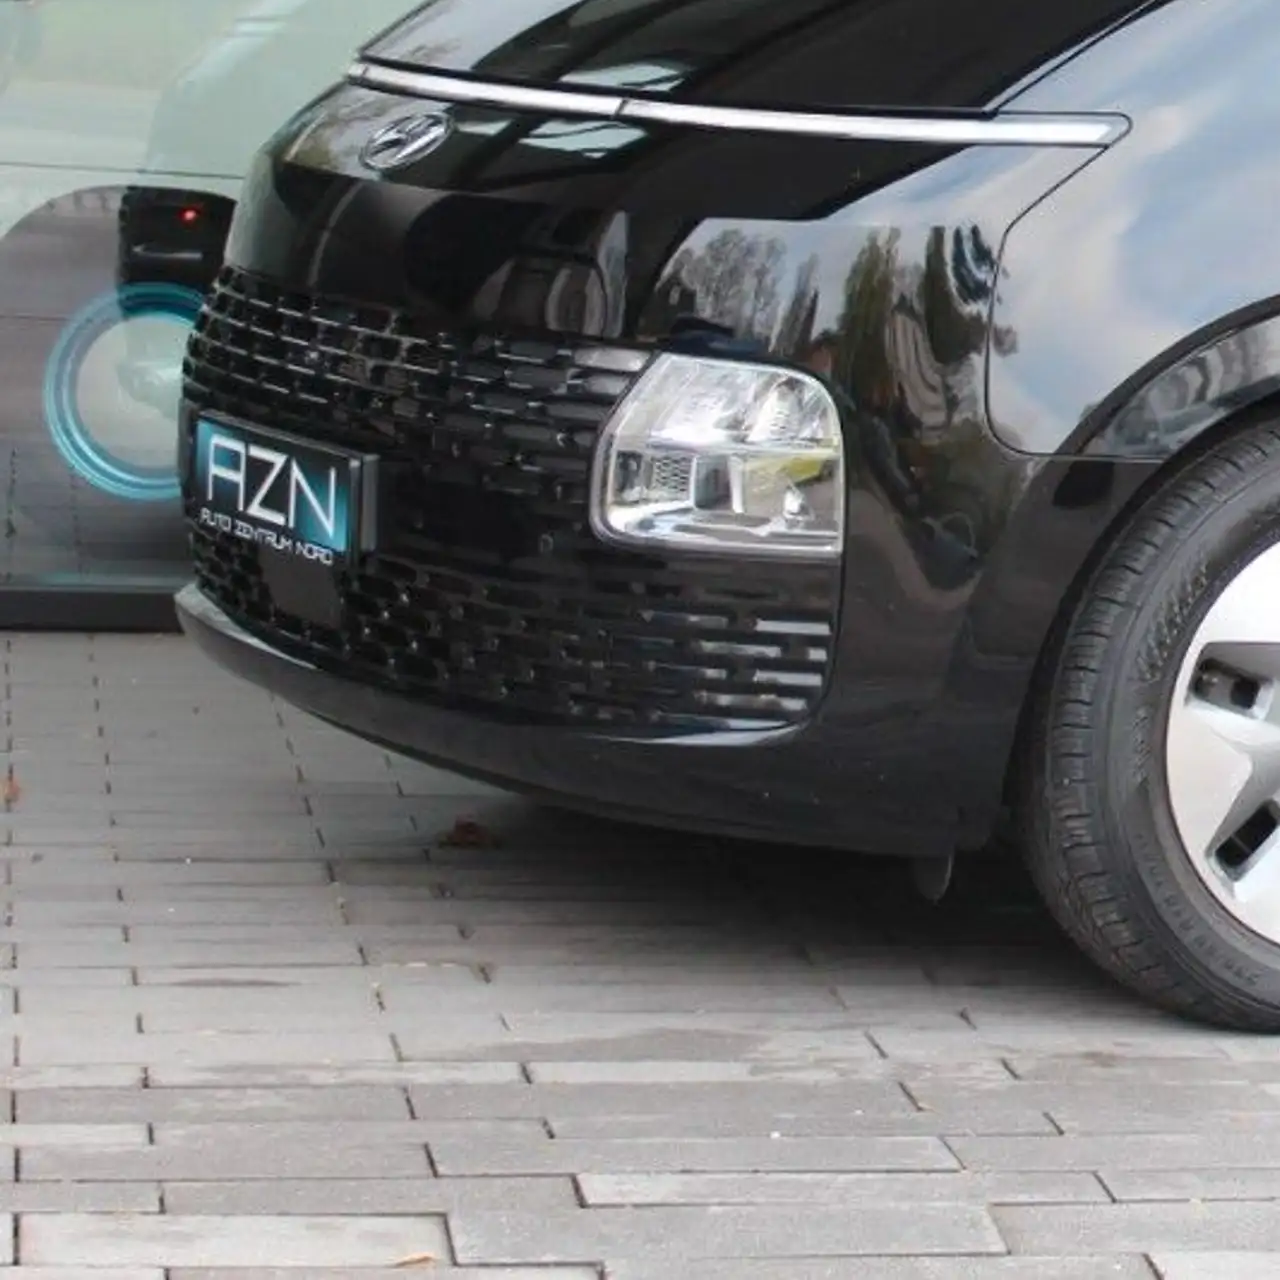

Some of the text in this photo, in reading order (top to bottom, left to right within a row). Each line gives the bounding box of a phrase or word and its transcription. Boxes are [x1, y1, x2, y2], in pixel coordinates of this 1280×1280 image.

[207, 433, 337, 540] AZN
[200, 507, 334, 565] AUTO ZENTRUM NORD
